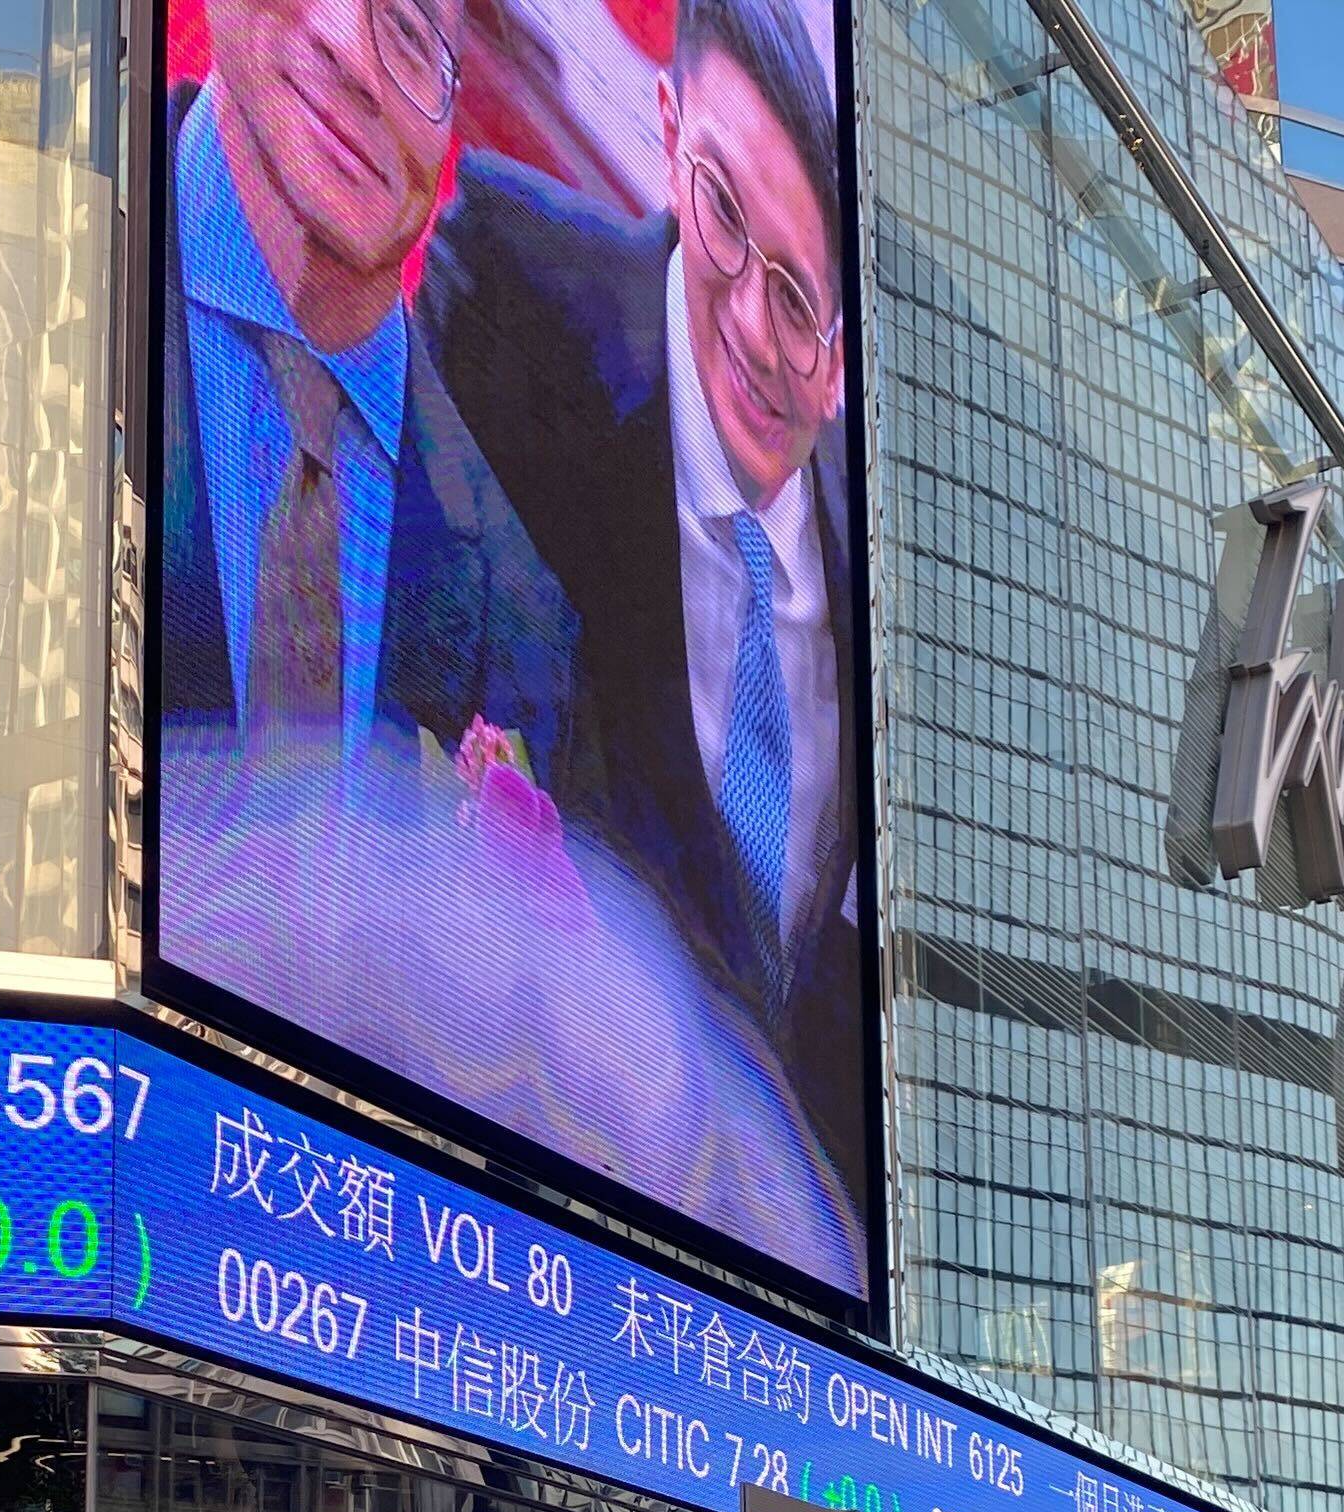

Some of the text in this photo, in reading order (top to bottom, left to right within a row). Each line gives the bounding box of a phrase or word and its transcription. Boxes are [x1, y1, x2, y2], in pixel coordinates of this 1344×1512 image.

[210, 1107, 396, 1262] 成交額
[417, 1195, 511, 1293] VOL
[528, 1243, 573, 1316] 80
[610, 1276, 810, 1425] 未平倉合約
[827, 1372, 908, 1451] OPEN
[916, 1407, 957, 1469] INT
[968, 1431, 1024, 1497] 6125
[218, 1247, 369, 1360] 00267
[393, 1306, 597, 1452] 中信股份
[615, 1393, 711, 1479] CITIC
